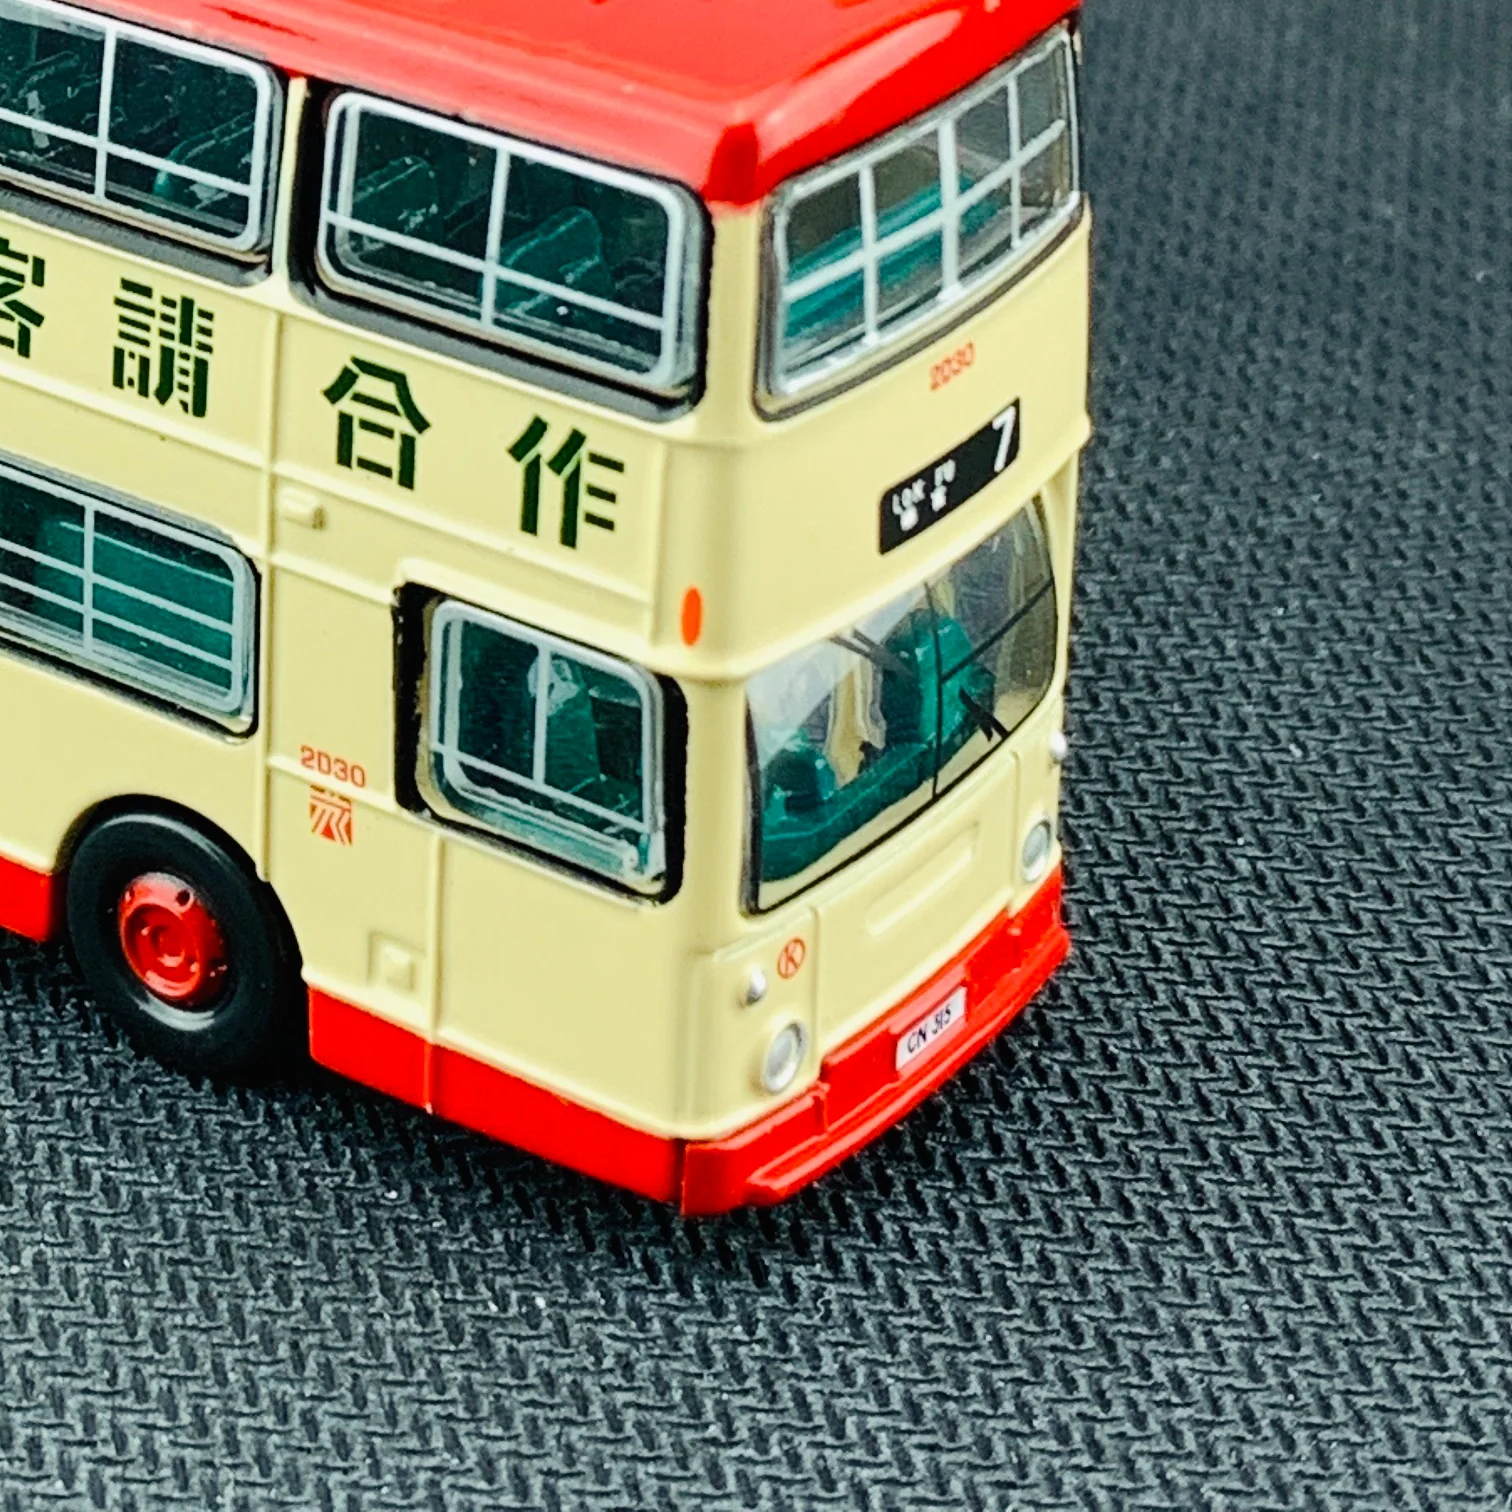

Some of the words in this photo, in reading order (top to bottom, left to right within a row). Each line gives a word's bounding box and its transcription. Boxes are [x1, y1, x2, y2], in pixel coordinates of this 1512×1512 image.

[992, 405, 1016, 473] 7
[300, 744, 366, 788] 2030
[907, 1022, 928, 1053] CN
